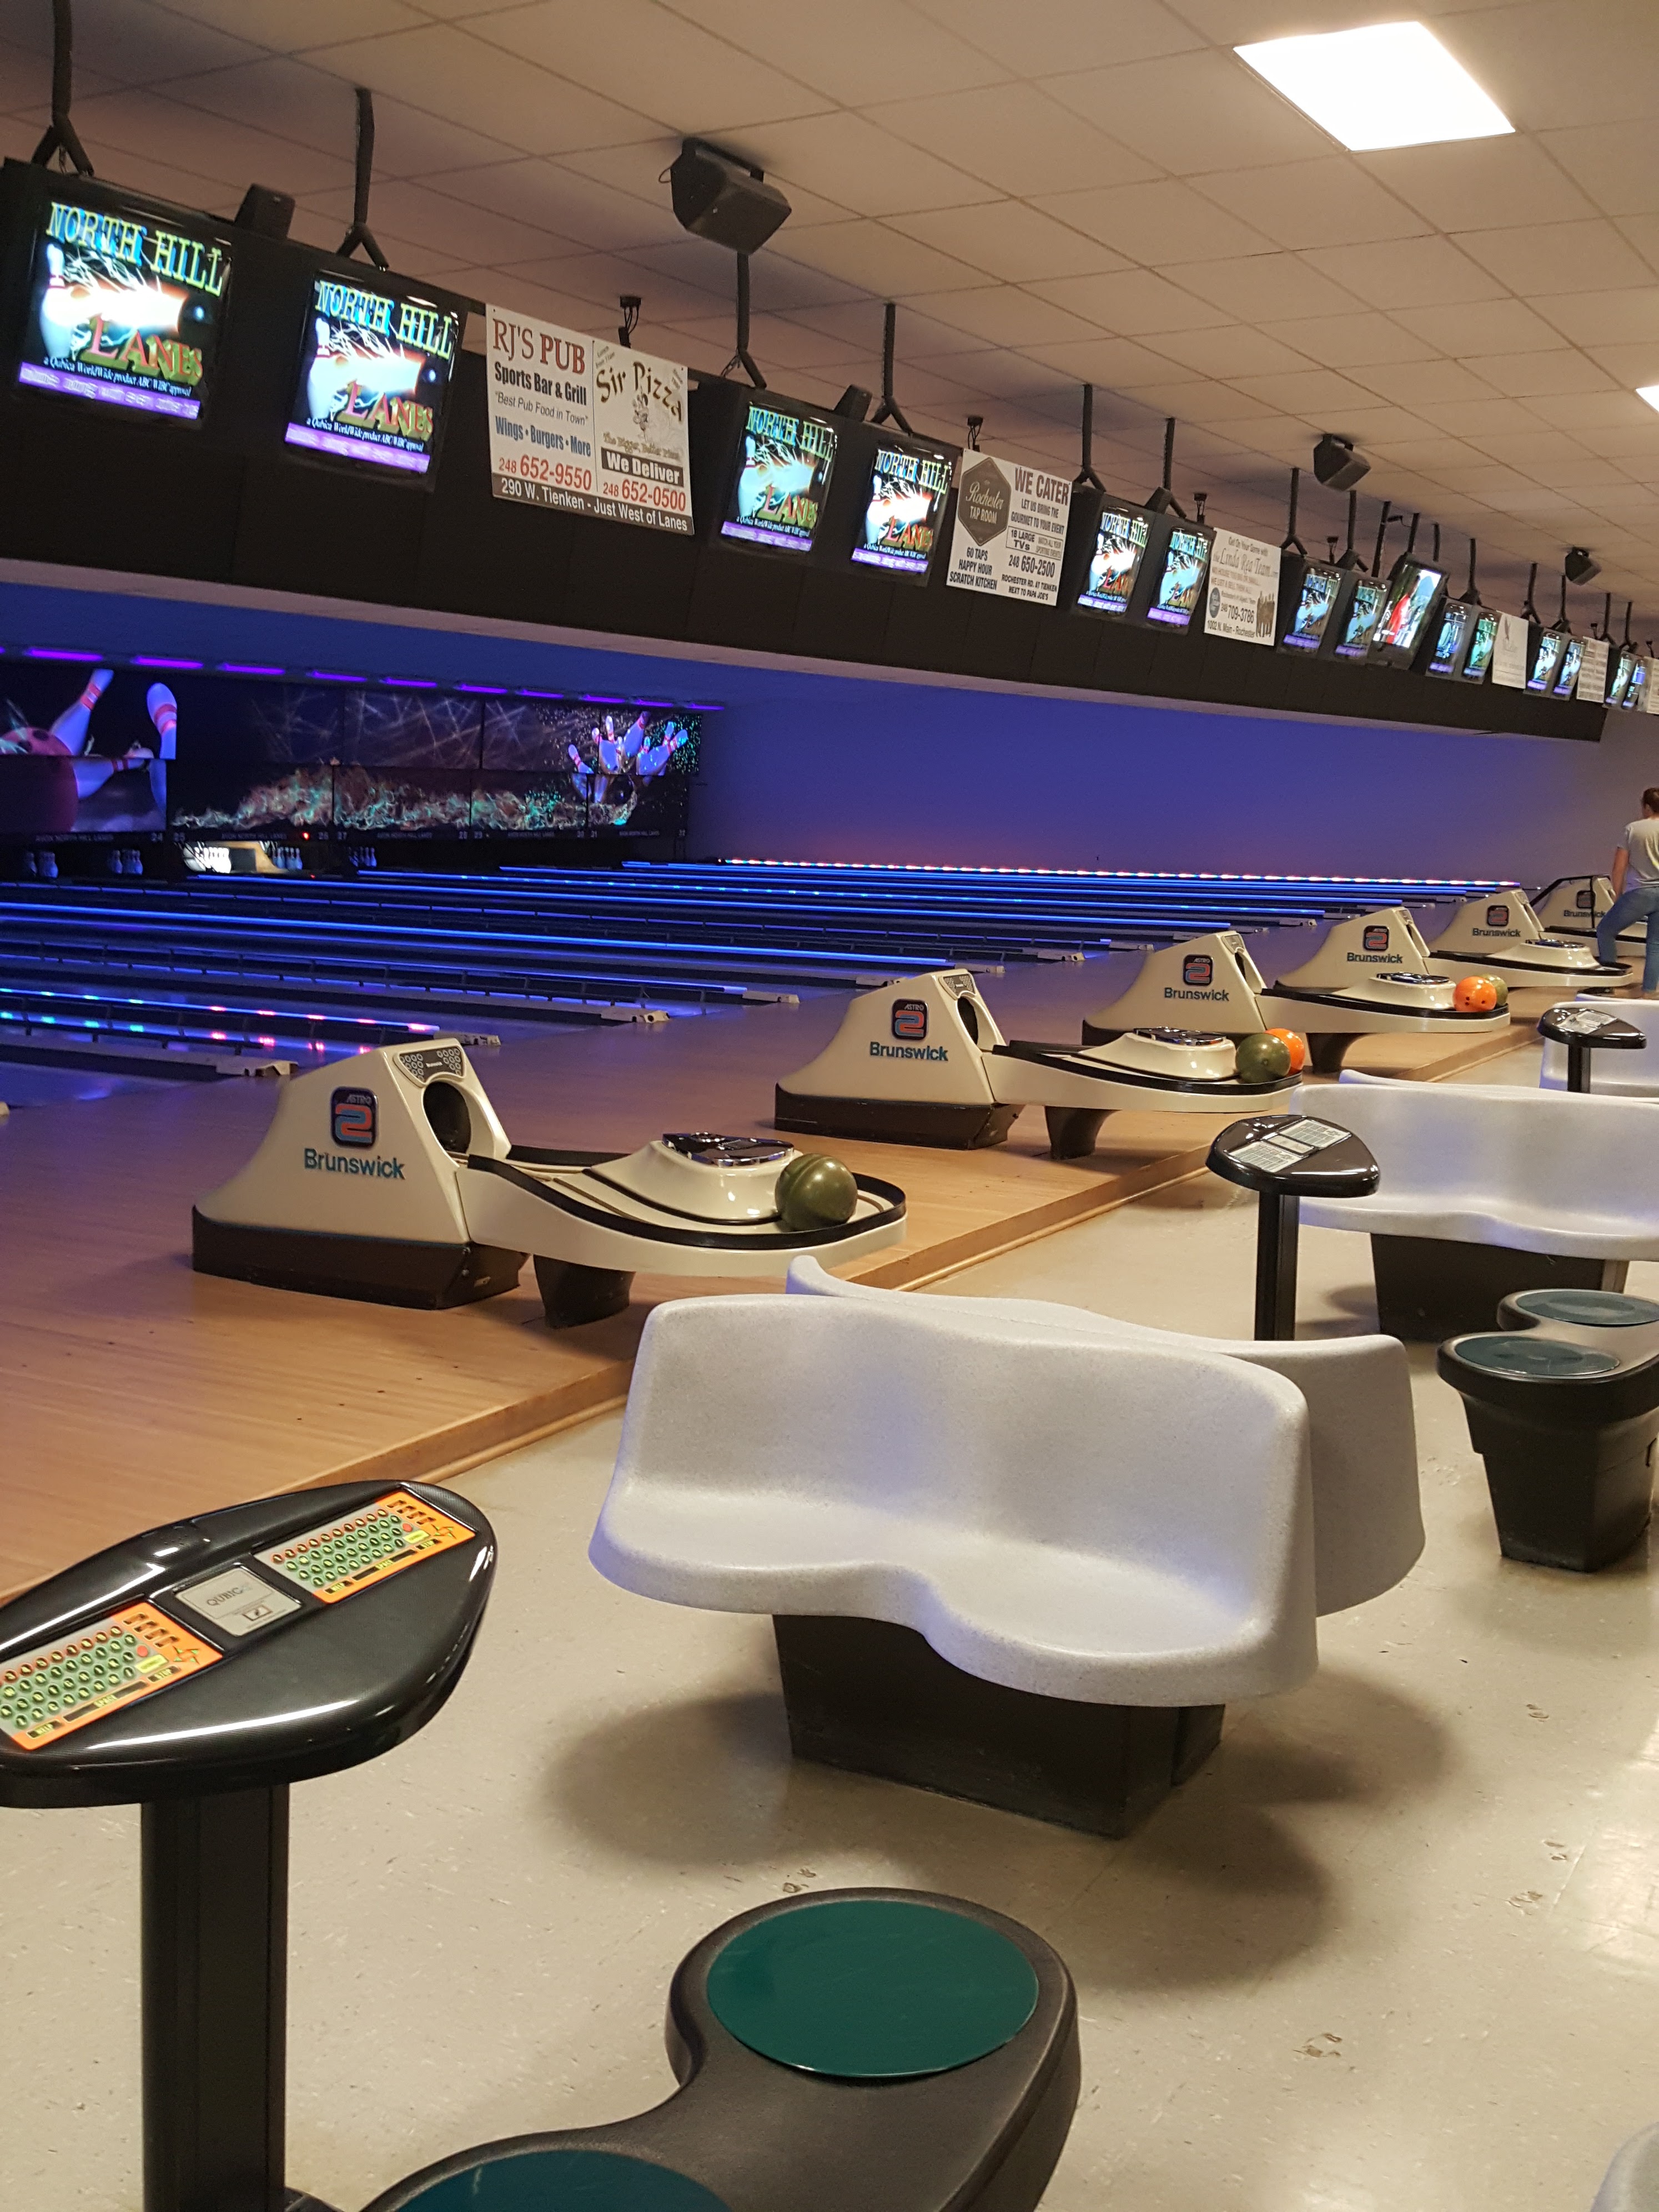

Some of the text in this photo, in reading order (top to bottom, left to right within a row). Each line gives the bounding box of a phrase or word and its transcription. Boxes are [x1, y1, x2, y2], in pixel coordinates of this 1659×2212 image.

[46, 202, 222, 296] NORTH HILL
[315, 280, 452, 360] NORTH HILL
[82, 313, 203, 385] LANES
[493, 318, 534, 361] RJ'S
[540, 332, 585, 375] PUB
[495, 361, 586, 406] Sports Bar & Grill
[596, 366, 626, 404] Sir
[633, 361, 682, 423] Pizza
[336, 381, 434, 441] LANES
[518, 397, 533, 412] Pub
[536, 401, 554, 418] Food
[557, 409, 563, 420] in
[495, 415, 591, 457] Wings Burgers More
[746, 406, 799, 446] NORTH
[499, 454, 592, 492] 248 652-9550
[606, 450, 680, 485] We Deliver
[874, 449, 948, 494] NORTH HILL
[603, 479, 686, 512] 248 652-0500
[966, 481, 1004, 510] Rochester
[1015, 467, 1070, 506] WE CATER
[501, 477, 521, 496] 290
[525, 482, 540, 501] W.
[542, 486, 585, 510] Tienken
[594, 498, 617, 517] Just
[619, 502, 644, 523] West
[646, 510, 656, 525] of
[658, 511, 688, 531] Lanes
[1022, 499, 1030, 509] LET
[1030, 501, 1037, 512] US
[970, 506, 998, 525] TAP ROOM
[1034, 517, 1039, 528] TO
[1011, 529, 1035, 542] 18 LARGE
[1014, 539, 1030, 550] TVs
[967, 547, 988, 561] 60 TAPS
[958, 559, 992, 576] HAPPY HOUR
[1008, 555, 1055, 578] 248 650-2500
[949, 571, 997, 591] SCRATCH KITCHEN
[1002, 574, 1027, 586] ROCHESTER
[1008, 586, 1020, 595] NEXT
[1228, 605, 1255, 624] 709-3786
[1472, 928, 1521, 937] Brunswick
[1347, 952, 1403, 963] Brunswick
[1164, 987, 1229, 1002] Brunswick
[870, 1041, 948, 1061] Brunswick
[346, 1094, 372, 1105] ASTRO
[304, 1147, 406, 1180] Brunswick
[155, 1668, 172, 1680] STOP
[93, 1695, 117, 1707] SPACE
[36, 1723, 54, 1735] HELP
